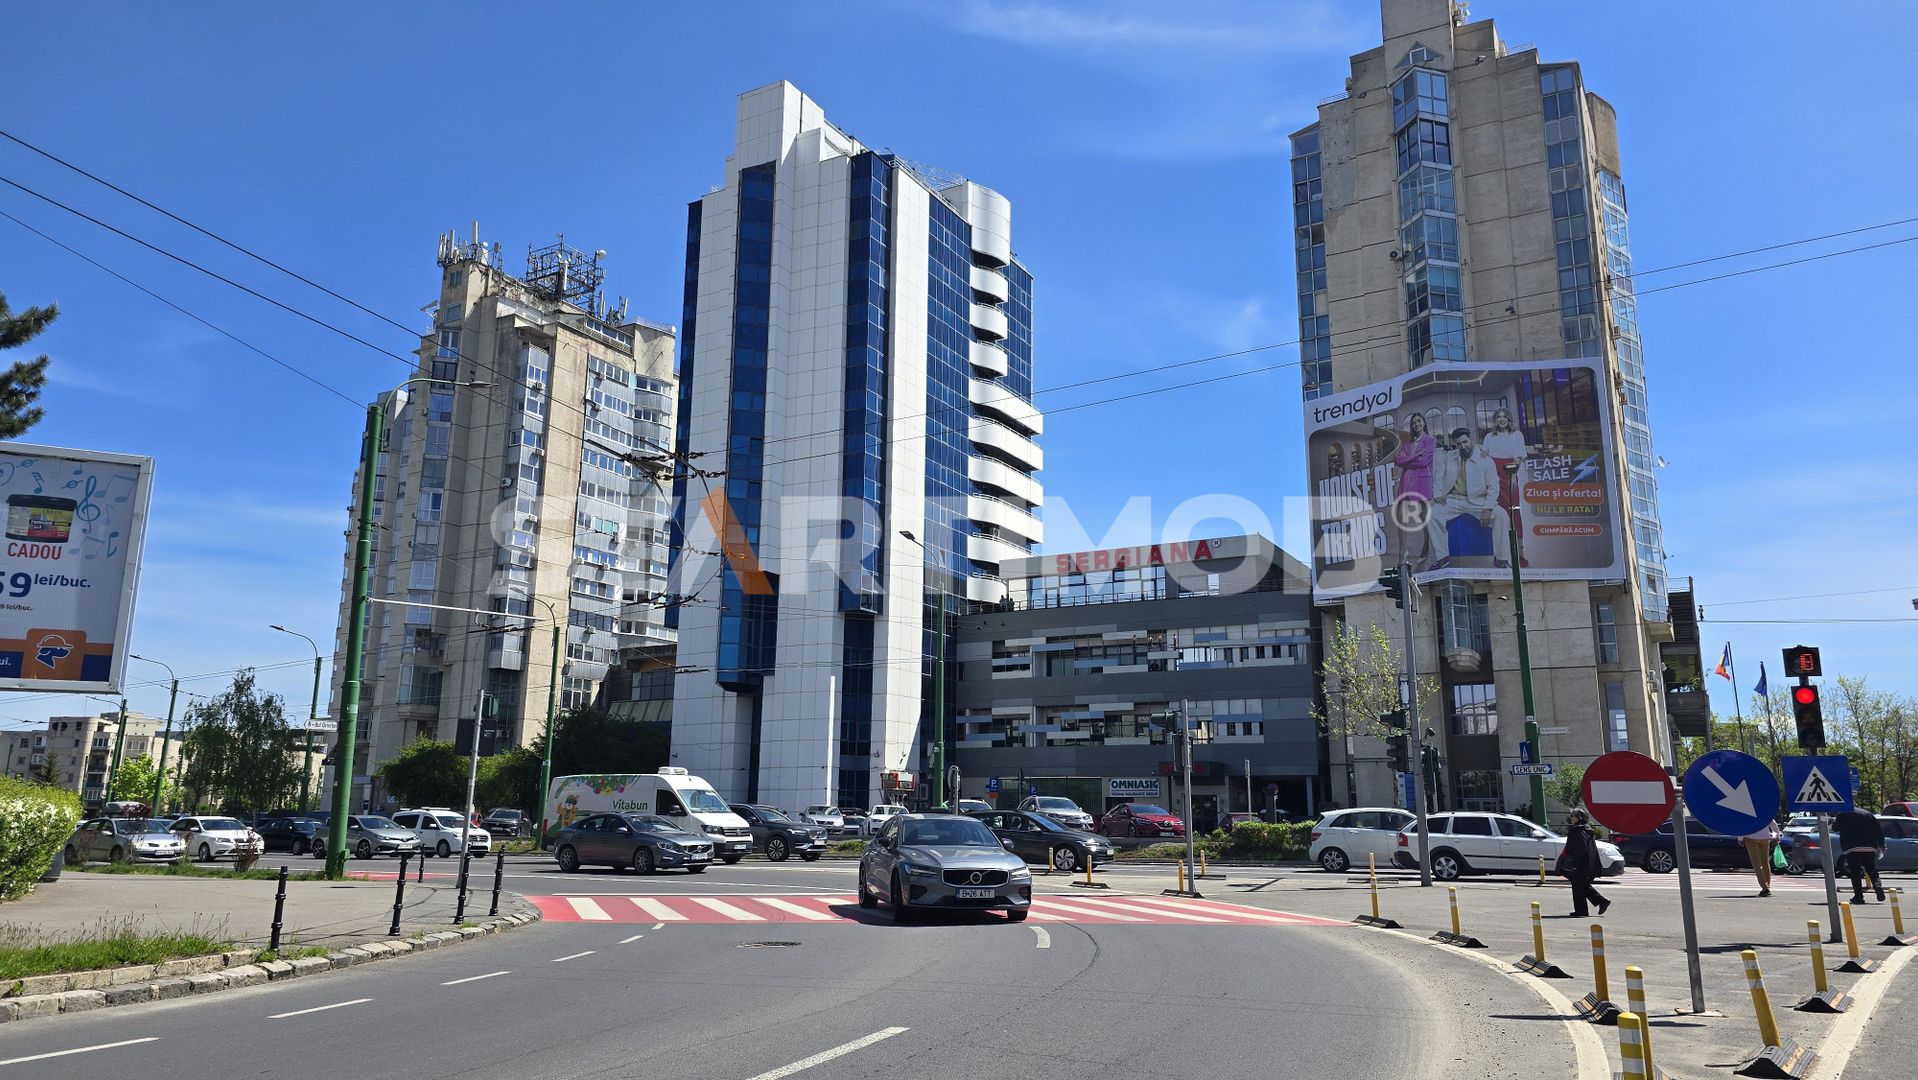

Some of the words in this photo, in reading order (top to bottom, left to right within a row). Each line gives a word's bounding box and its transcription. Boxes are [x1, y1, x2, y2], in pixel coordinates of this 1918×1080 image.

[1314, 386, 1393, 424] trendyol
[1525, 455, 1572, 471] FLASH
[1533, 467, 1570, 482] SALE
[1319, 468, 1373, 521] HOUSE
[1374, 462, 1397, 509] OF
[1526, 488, 1550, 497] Ziua
[1563, 488, 1601, 498] oferta!
[1322, 511, 1387, 565] TRENDS
[8, 542, 62, 560] CADOU
[34, 573, 91, 588] lei/buc.
[1515, 766, 1532, 774] SENS
[1111, 780, 1158, 789] OMNIASIG
[613, 800, 648, 810] Vitabun
